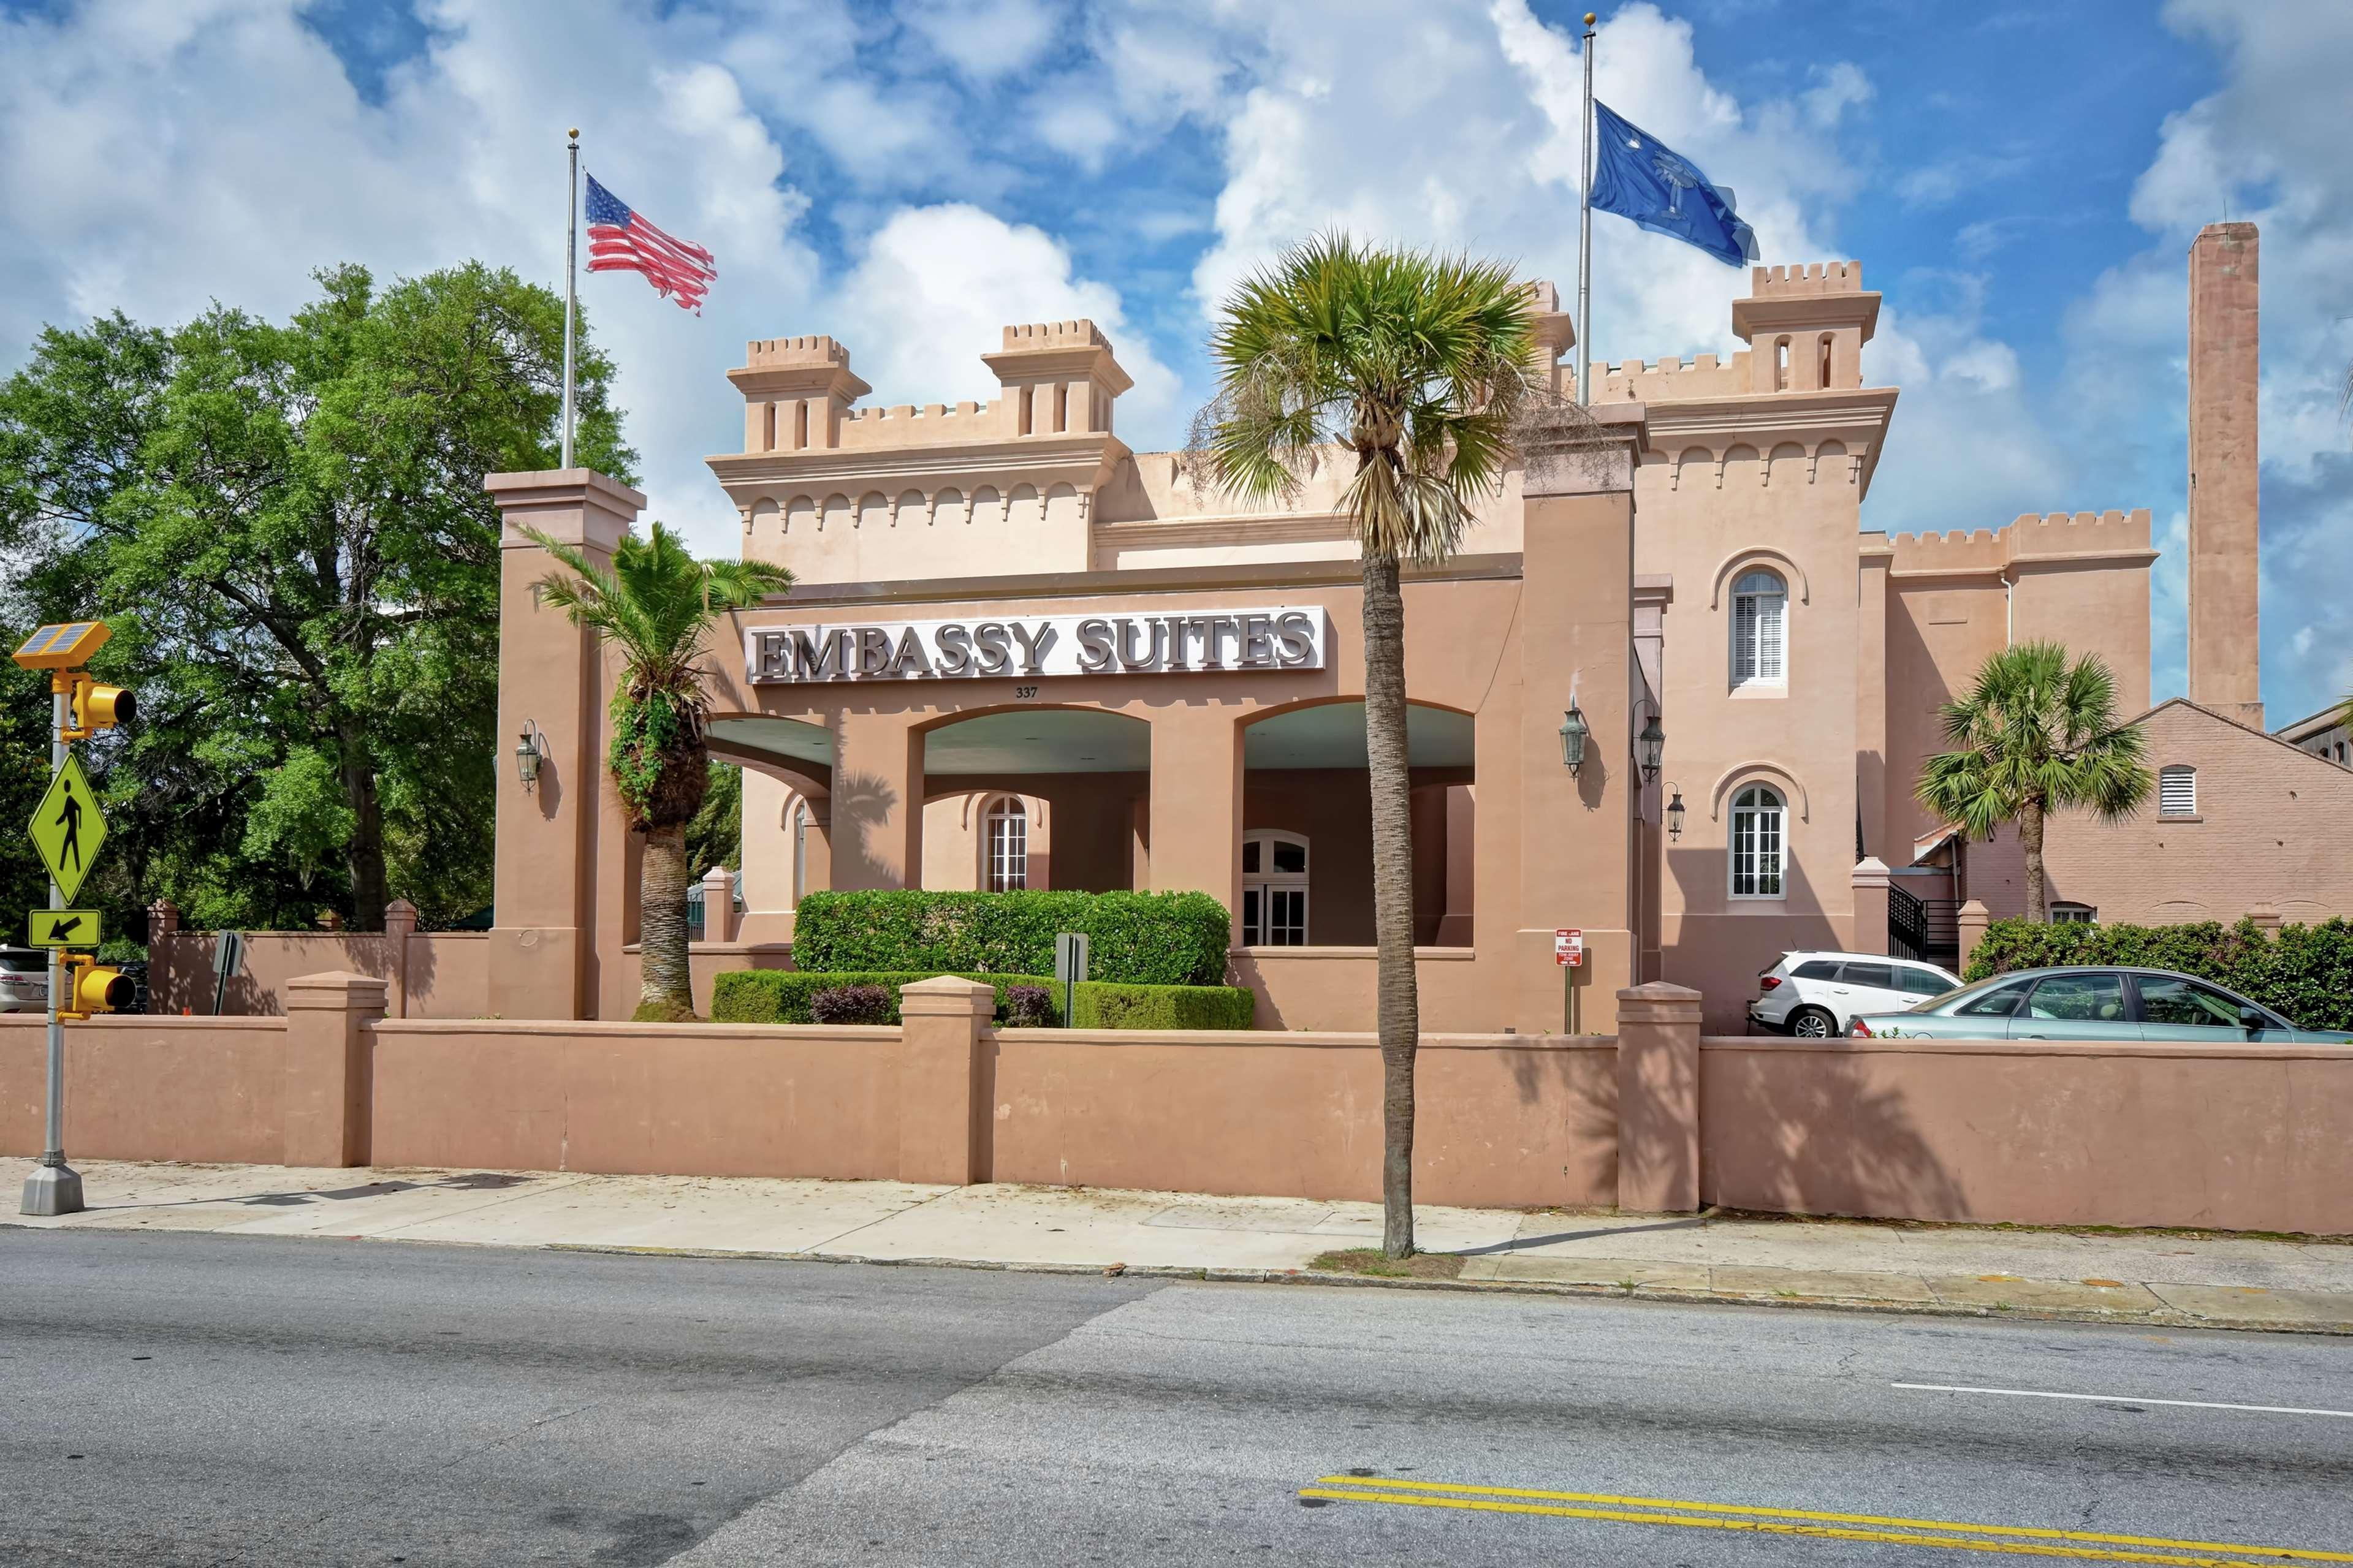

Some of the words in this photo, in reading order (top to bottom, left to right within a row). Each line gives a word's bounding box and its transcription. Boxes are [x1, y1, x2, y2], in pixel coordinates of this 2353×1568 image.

[751, 621, 1052, 676] EMBASSY
[1076, 611, 1313, 668] SUITES
[1016, 686, 1038, 699] 337
